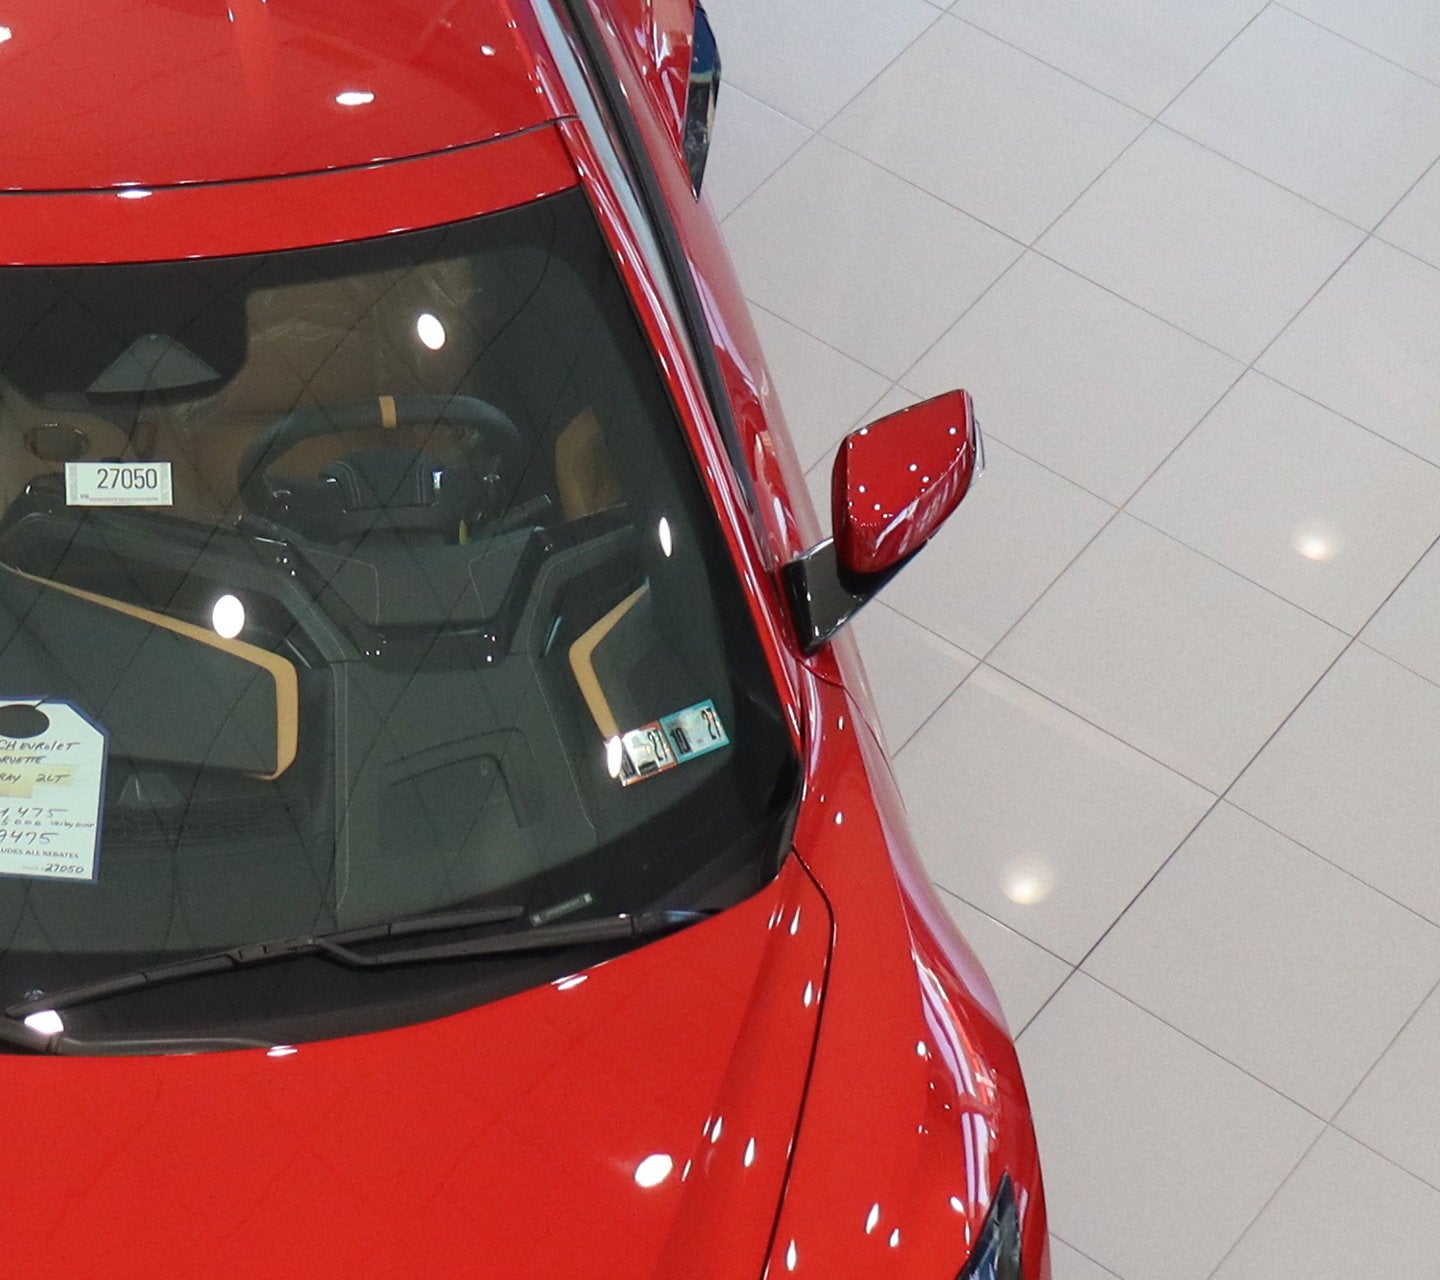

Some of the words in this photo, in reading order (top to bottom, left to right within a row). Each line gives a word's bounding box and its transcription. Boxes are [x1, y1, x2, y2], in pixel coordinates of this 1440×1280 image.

[96, 468, 158, 489] 27050
[25, 849, 40, 857] ALL
[42, 851, 80, 859] REBATES
